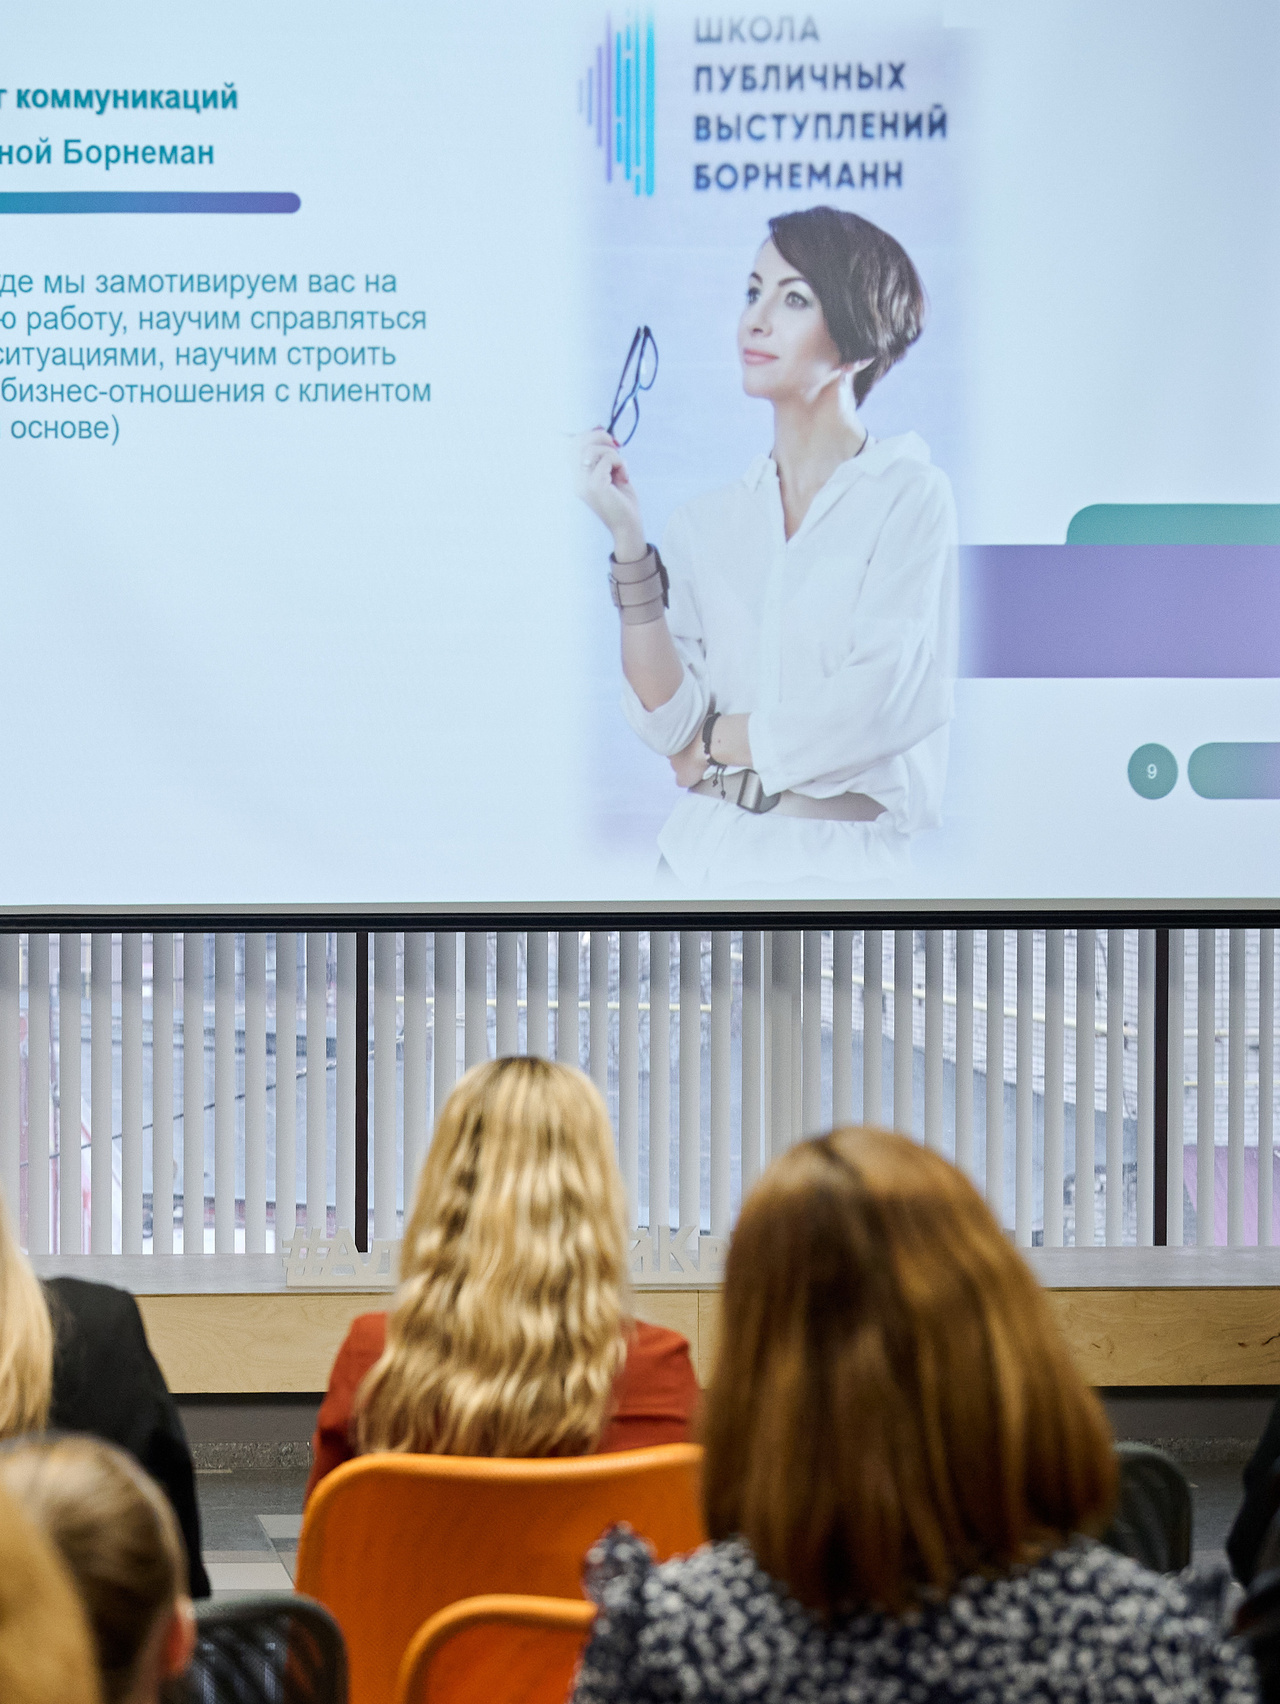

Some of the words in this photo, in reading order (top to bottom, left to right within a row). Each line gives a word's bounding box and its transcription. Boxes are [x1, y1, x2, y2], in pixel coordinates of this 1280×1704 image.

[694, 16, 820, 45] ШКОЛА
[694, 61, 907, 93] ПУБЛИЧНЫХ
[16, 82, 239, 116] коммуникаций
[694, 103, 948, 143] ВЫСТУПЛЕНИЙ
[64, 138, 215, 171] Борнеман
[694, 161, 904, 192] БОРНЕМАНН
[44, 273, 86, 295] мы
[95, 273, 298, 301] замотивируем
[308, 273, 356, 294] вас
[365, 273, 398, 294] на
[27, 304, 128, 337] работу,
[139, 310, 241, 337] научим
[251, 310, 427, 337] справляться
[176, 345, 277, 373] научим
[287, 345, 397, 373] строить
[1, 375, 265, 404] бизнес-отношения
[274, 382, 291, 403] с
[299, 382, 432, 403] клиентом
[10, 413, 120, 447] основе)
[1147, 763, 1158, 780] 9
